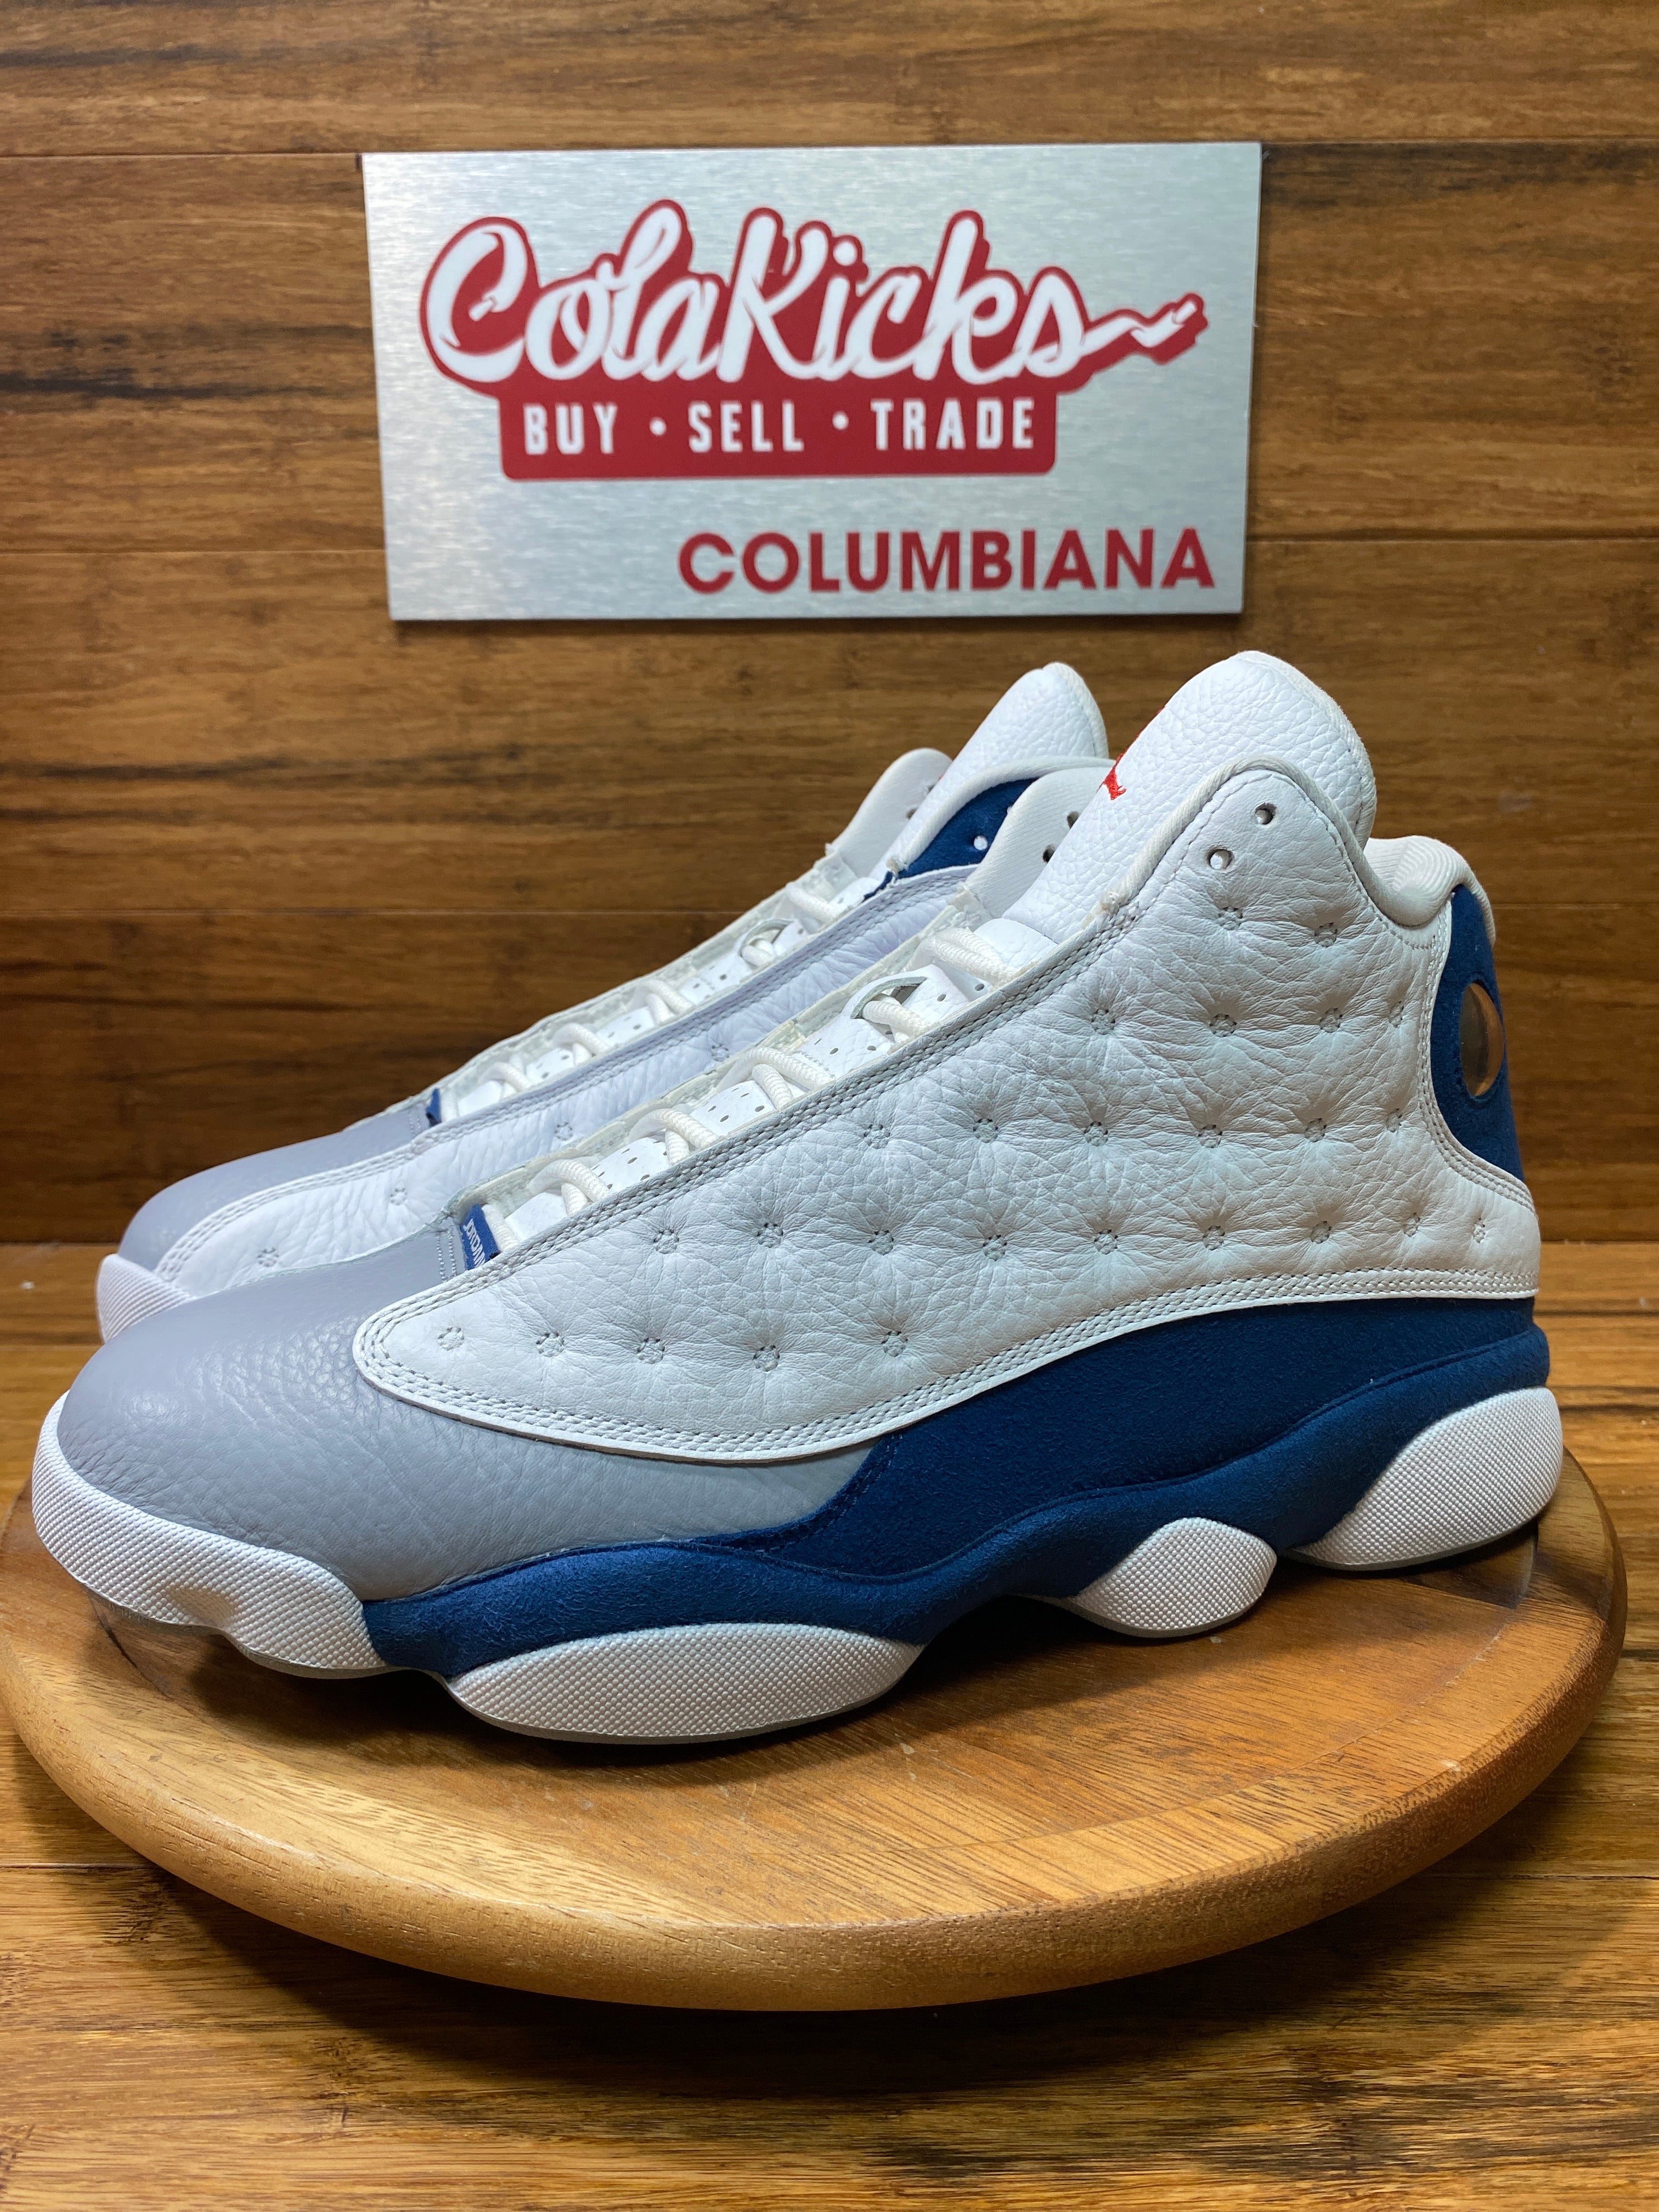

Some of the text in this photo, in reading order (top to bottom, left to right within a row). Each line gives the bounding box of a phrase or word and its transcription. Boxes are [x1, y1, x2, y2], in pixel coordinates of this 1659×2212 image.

[424, 203, 1201, 385] ColaKicks
[524, 398, 1035, 455] BUY SELL TRADE
[679, 527, 1215, 594] COLUMBIANA
